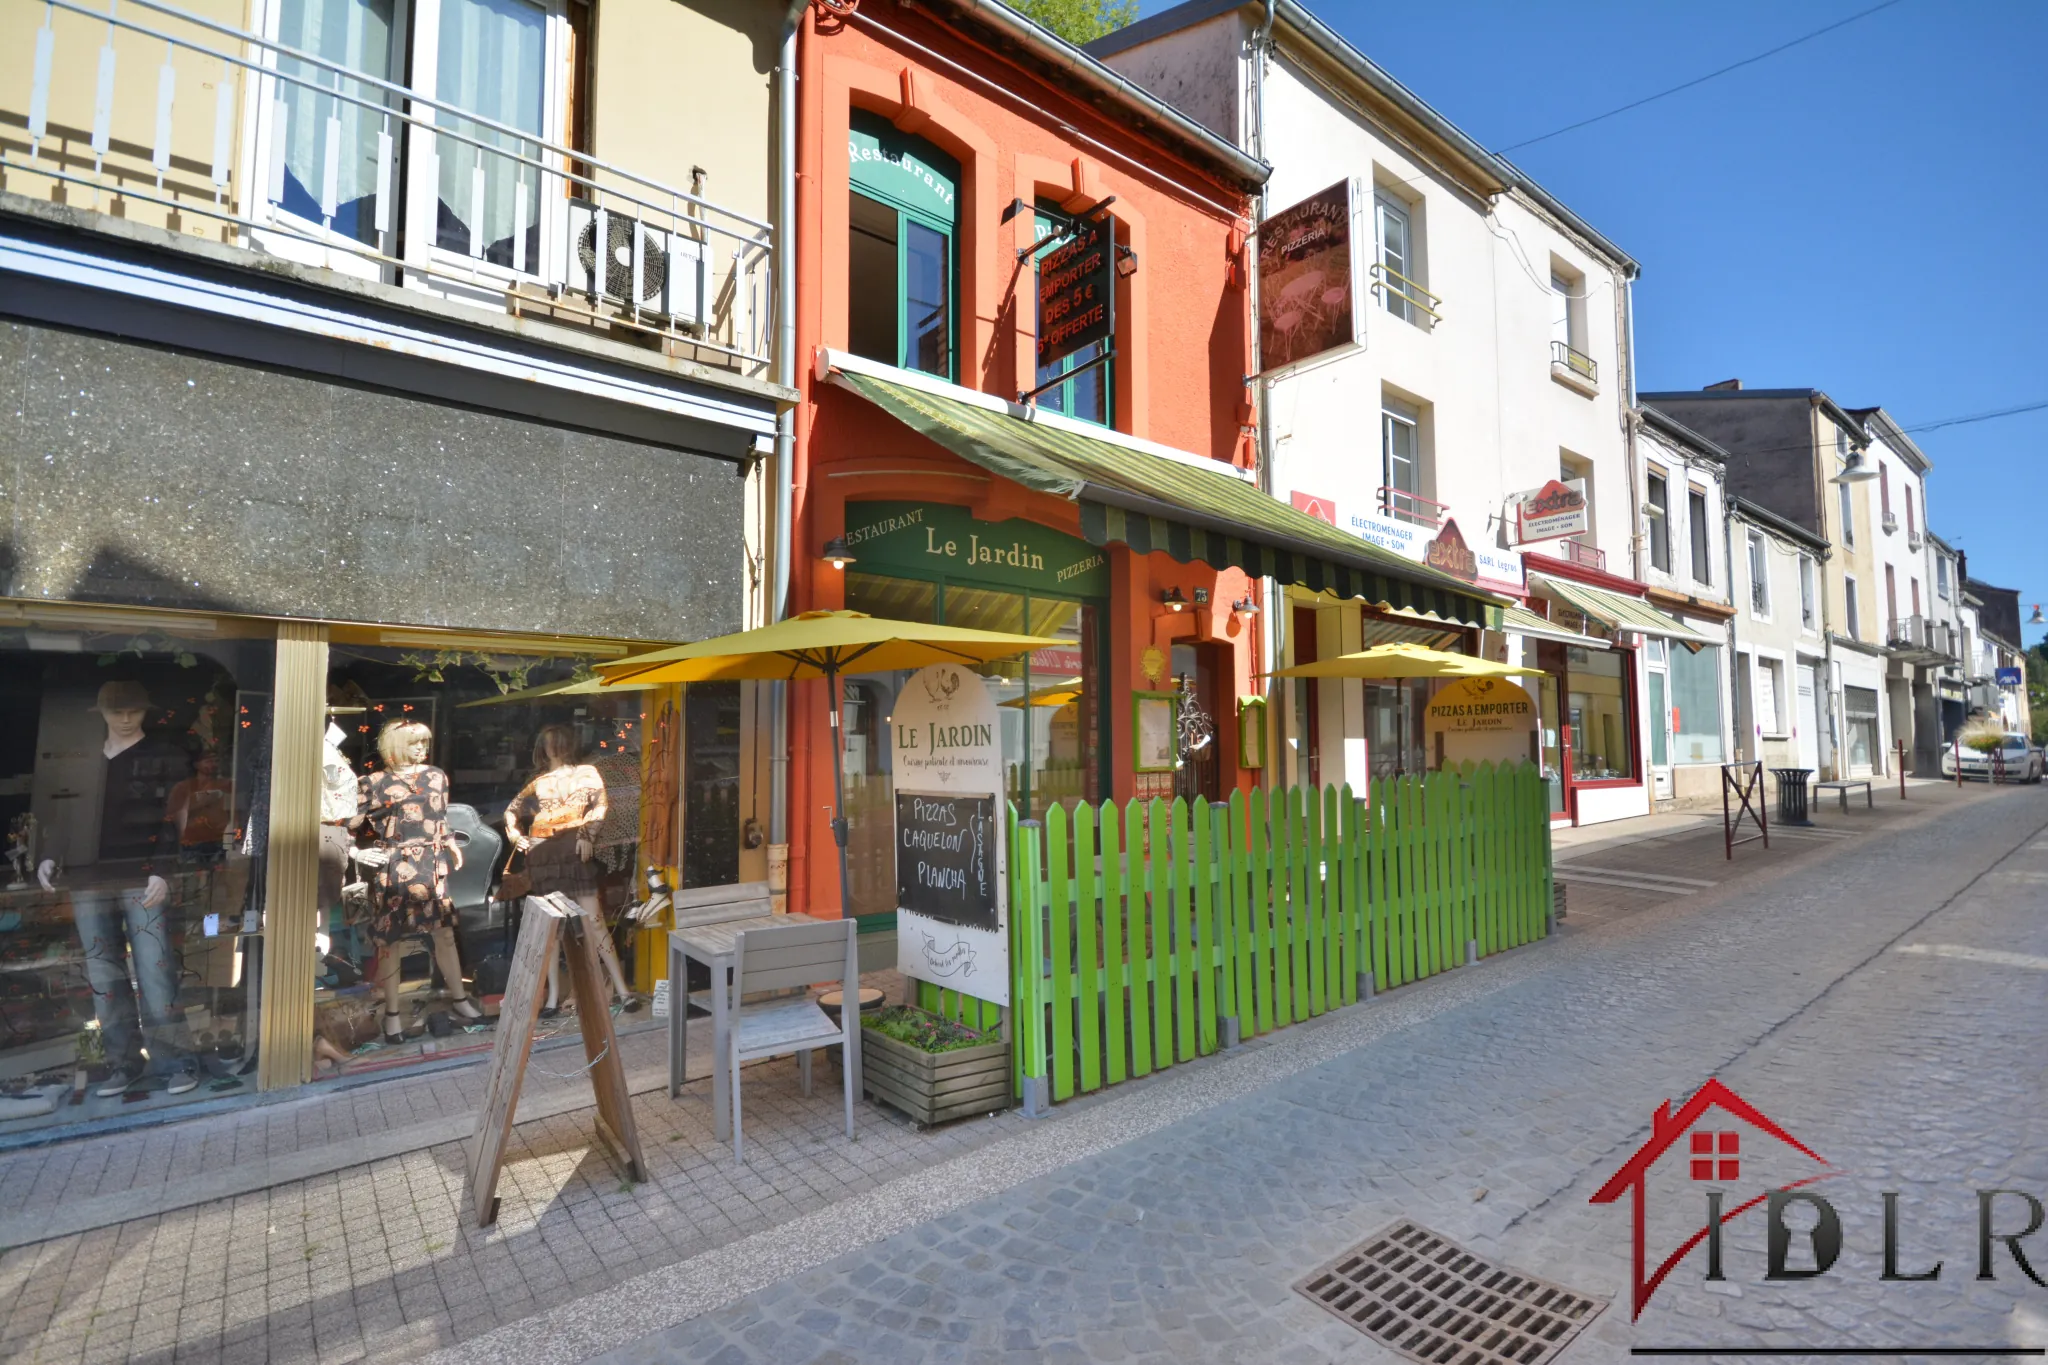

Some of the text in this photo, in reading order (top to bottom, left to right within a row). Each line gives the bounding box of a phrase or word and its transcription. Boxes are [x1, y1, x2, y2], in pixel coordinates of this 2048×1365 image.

[848, 141, 953, 205] Restaurant
[1261, 201, 1348, 259] RESTAURANT
[1281, 227, 1325, 255] PIZZERIA
[1041, 235, 1087, 277] PIZZAS
[1039, 252, 1101, 303] EMPORTER
[1073, 286, 1082, 307] 5
[1051, 303, 1103, 345] OFFERTE
[1525, 489, 1584, 516] extra
[846, 508, 923, 547] ESTAURANT
[1362, 532, 1405, 550] IMAGE SON
[1536, 525, 1555, 534] IMAGE
[926, 527, 1044, 570] Le Jardin
[1429, 537, 1476, 574] extra
[1479, 554, 1495, 567] SARL
[1056, 554, 1104, 583] PIZZERIA
[1431, 702, 1529, 717] PIZZAS A EMPORTER
[1472, 718, 1502, 728] JARDIN
[898, 722, 993, 756] LE JARDIN
[904, 828, 968, 853] CAQUELON
[918, 861, 967, 900] PLANCHA
